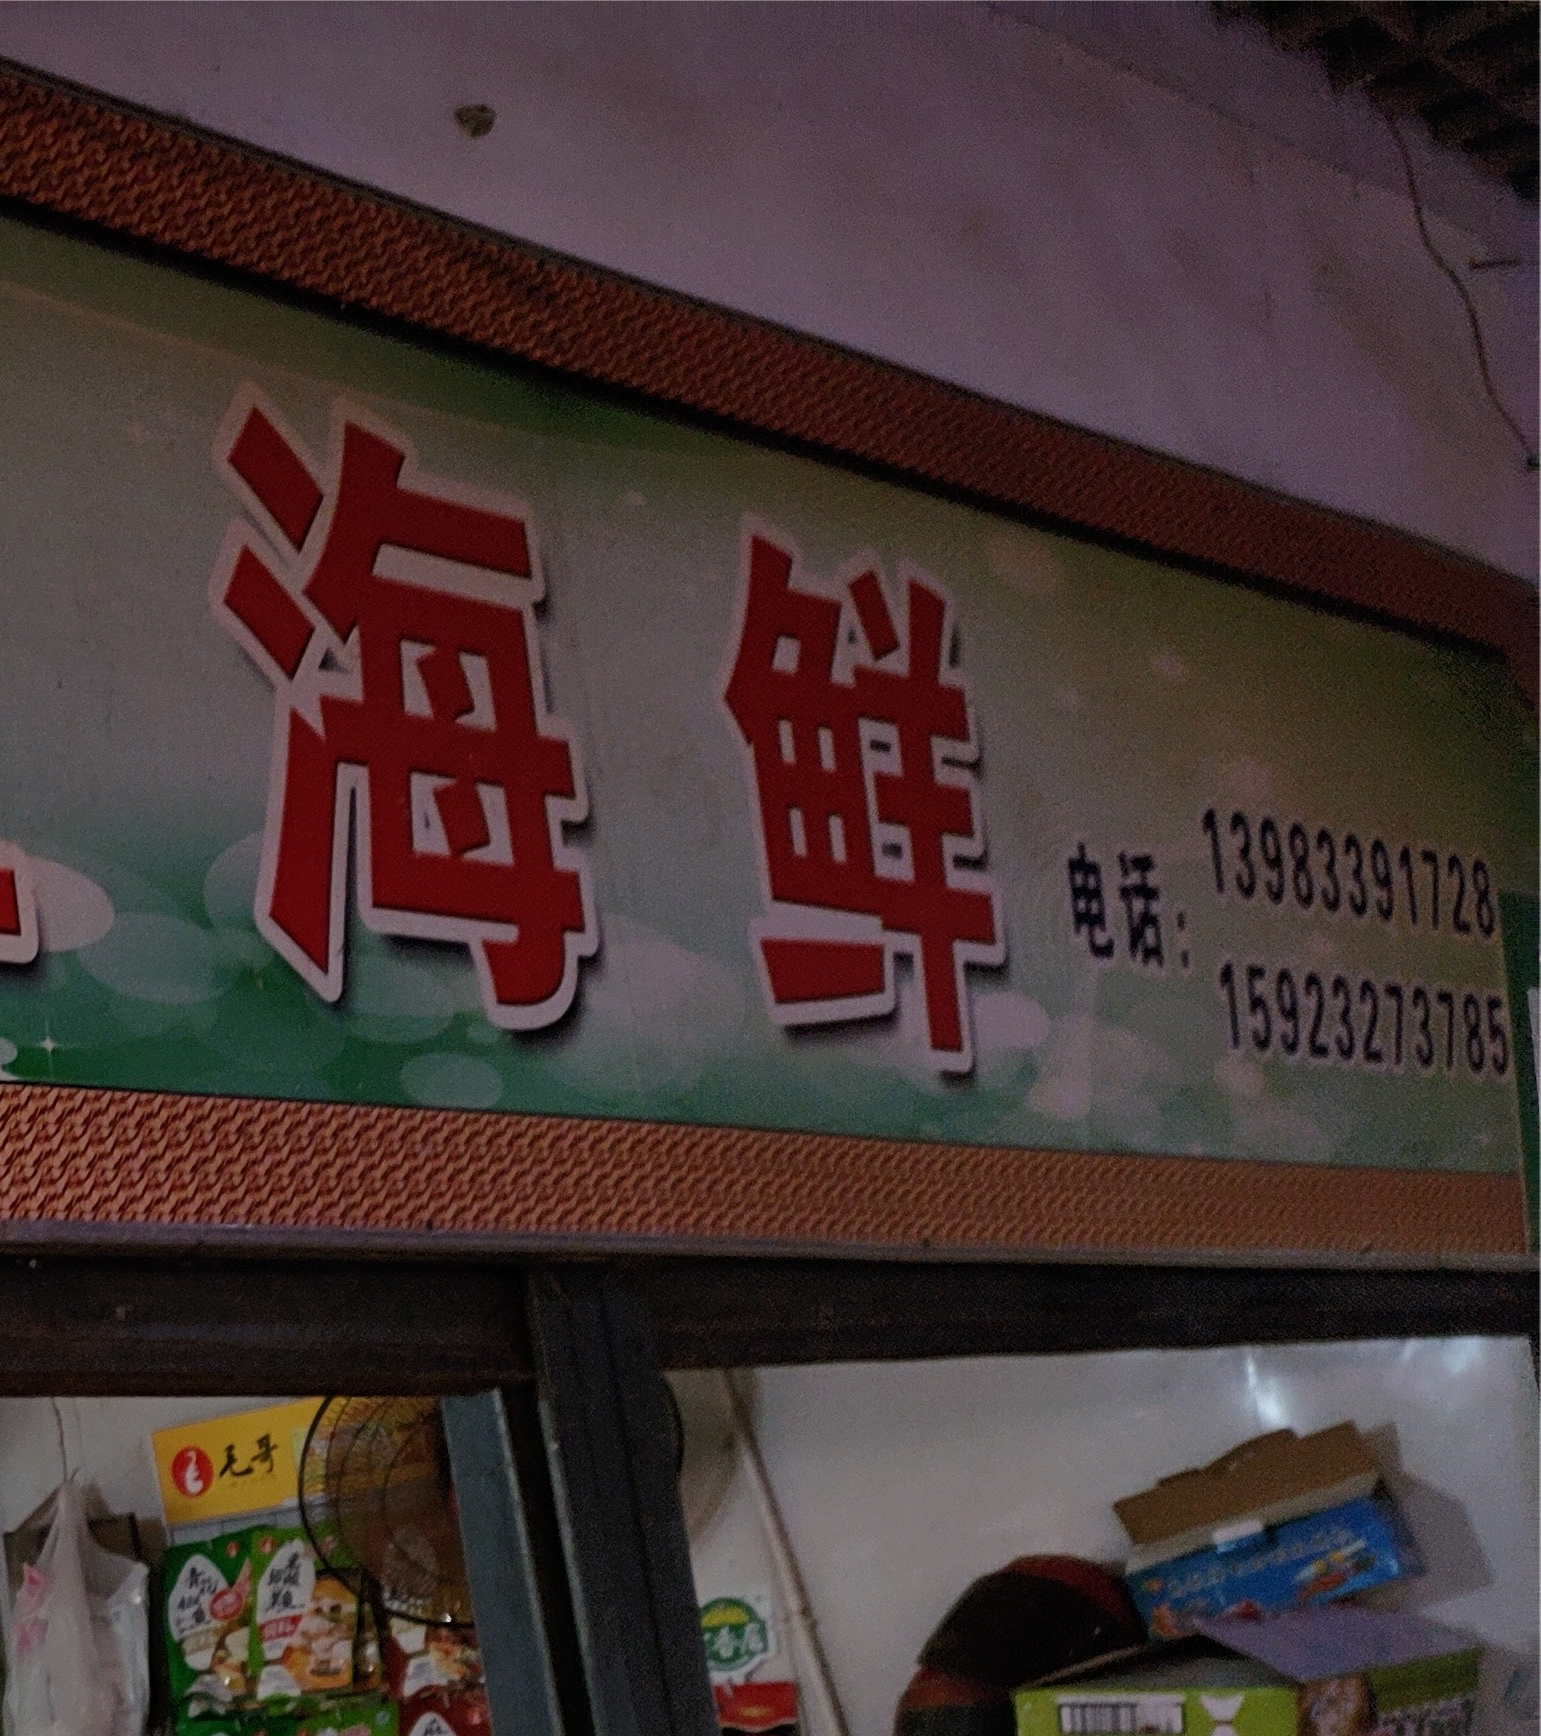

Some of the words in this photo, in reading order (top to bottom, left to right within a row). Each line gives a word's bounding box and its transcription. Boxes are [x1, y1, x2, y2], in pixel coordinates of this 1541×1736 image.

[1202, 807, 1495, 941] 13983391728
[1219, 960, 1509, 1075] 15923273785
[218, 1432, 280, 1479] 毛哥
